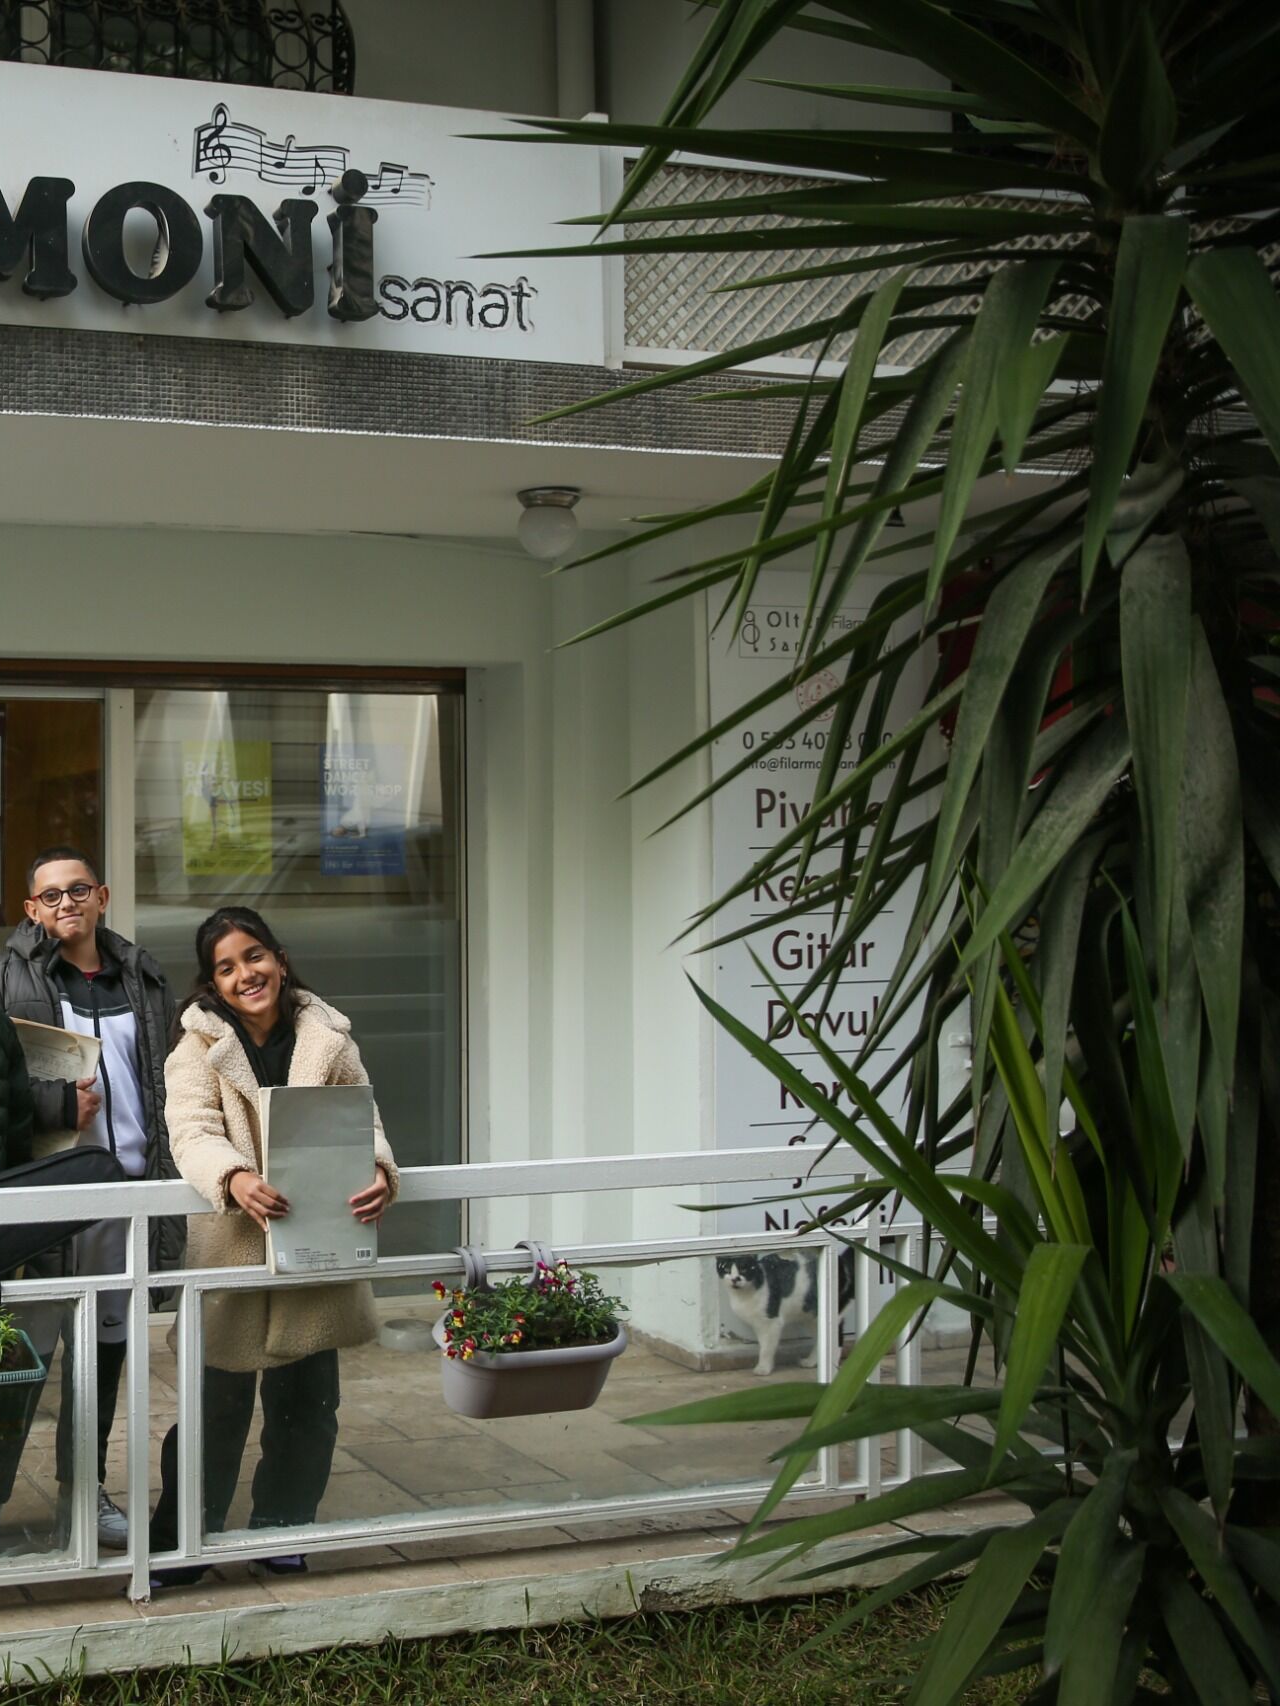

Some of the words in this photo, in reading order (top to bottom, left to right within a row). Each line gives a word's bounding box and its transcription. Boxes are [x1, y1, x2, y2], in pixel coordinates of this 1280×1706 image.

[378, 275, 536, 332] sanat
[767, 611, 824, 629] Olt
[802, 731, 832, 750] 40
[323, 758, 370, 771] STREET
[323, 784, 403, 797] WORSHOP
